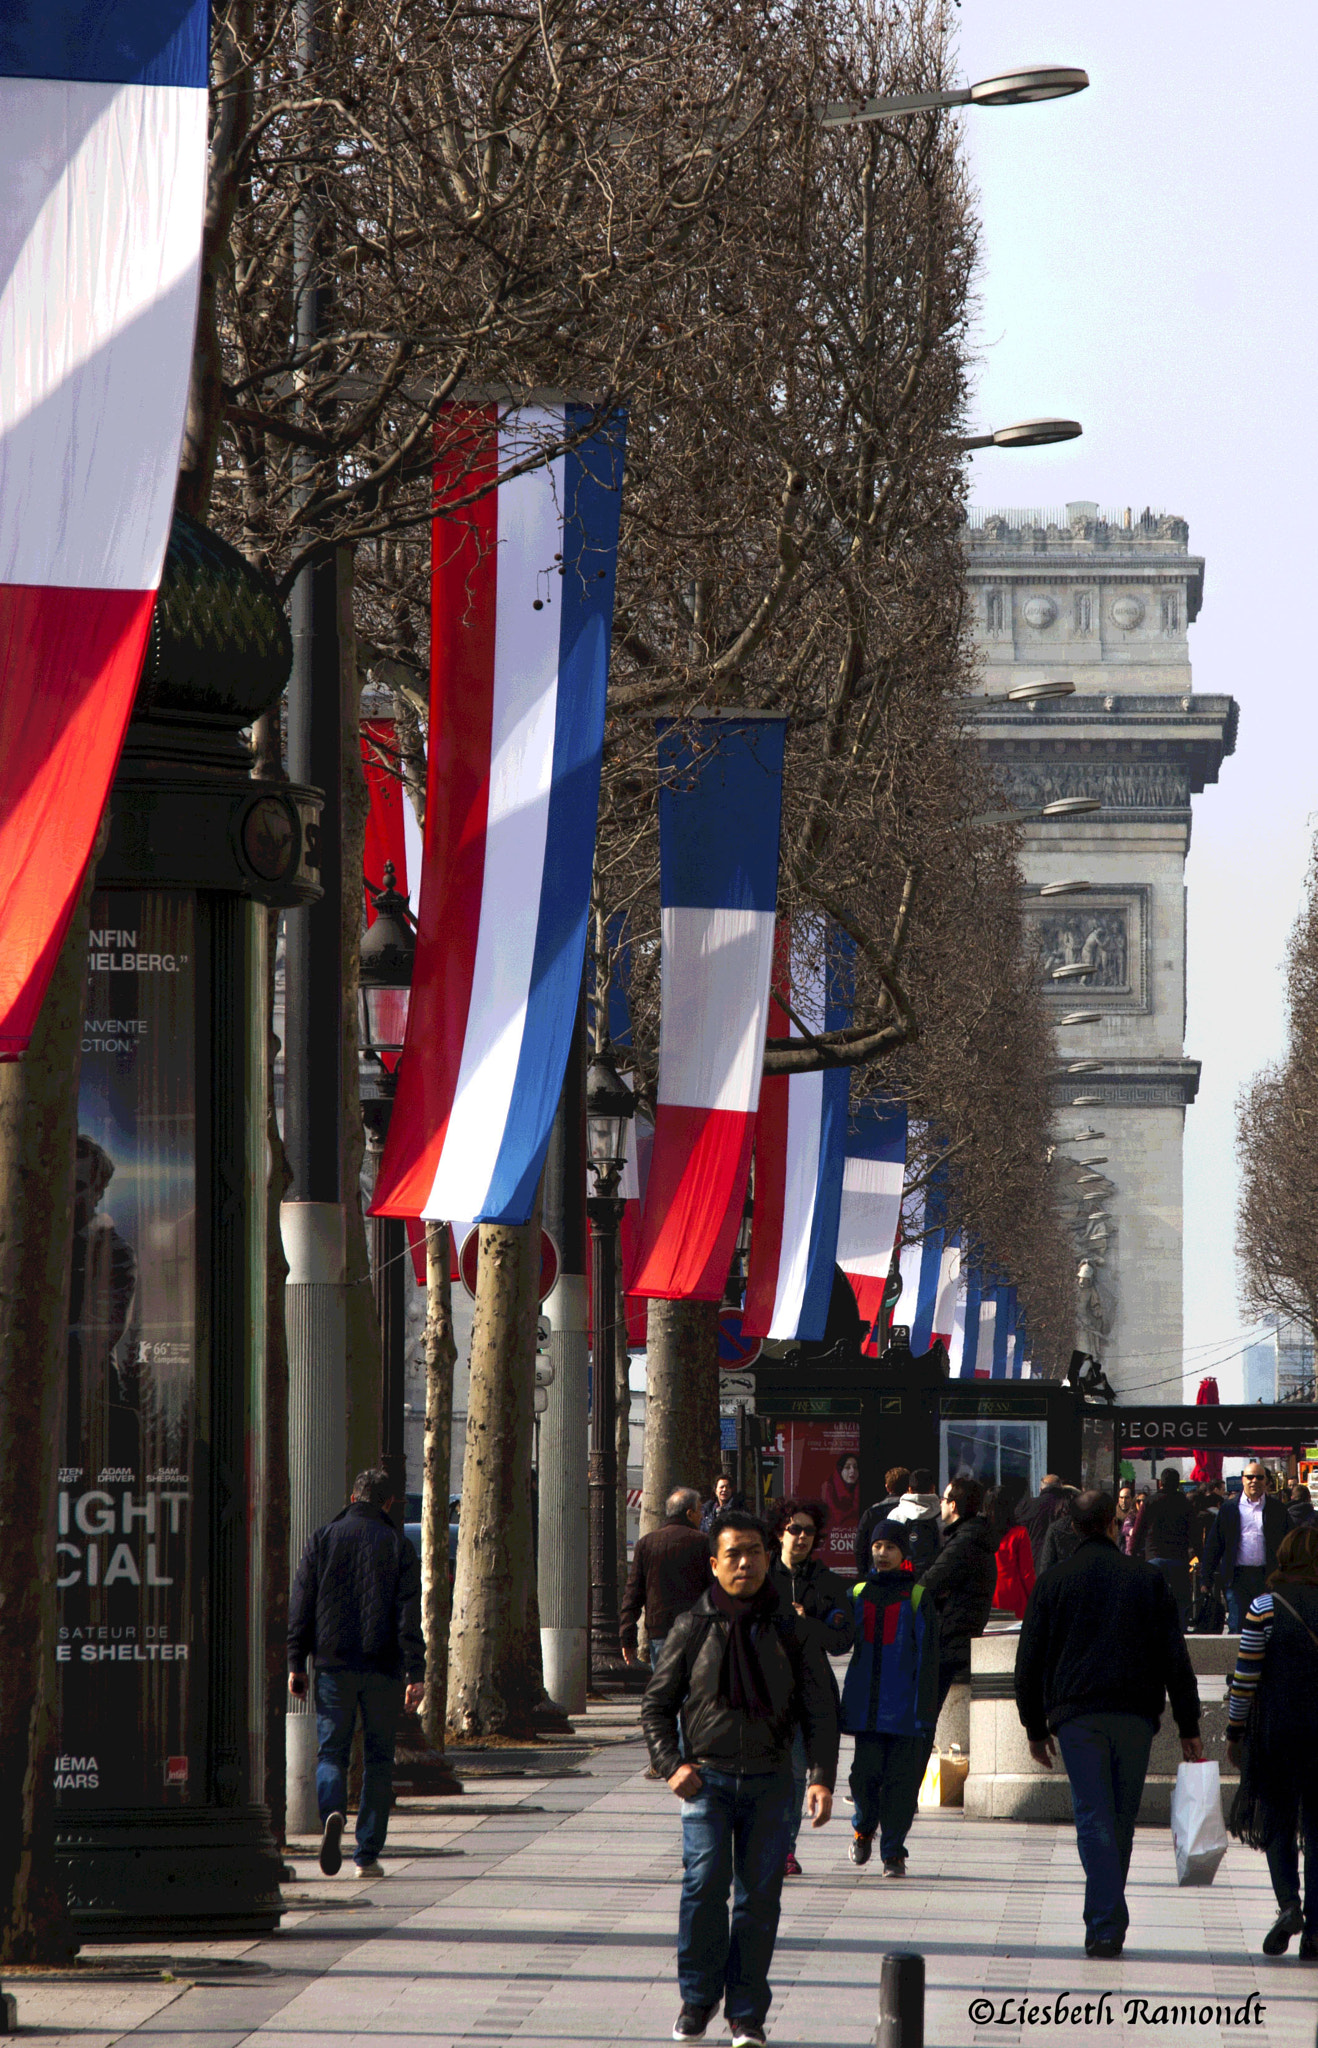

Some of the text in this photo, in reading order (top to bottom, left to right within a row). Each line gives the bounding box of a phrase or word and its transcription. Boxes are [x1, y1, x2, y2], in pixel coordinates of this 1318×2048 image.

[87, 953, 189, 973] IELBERG.”
[893, 1327, 906, 1337] 73
[792, 1400, 829, 1413] PRESSE
[1218, 1421, 1233, 1437] V
[101, 1467, 132, 1475] ADAM
[158, 1467, 179, 1475] SAM
[97, 1475, 135, 1483] DRIVER
[145, 1475, 190, 1483] SHEPARD
[58, 1490, 190, 1535] IGHT
[55, 1542, 174, 1588] CIAL
[58, 1626, 168, 1639] SATEUR DE
[56, 1644, 189, 1661] E SHELTER
